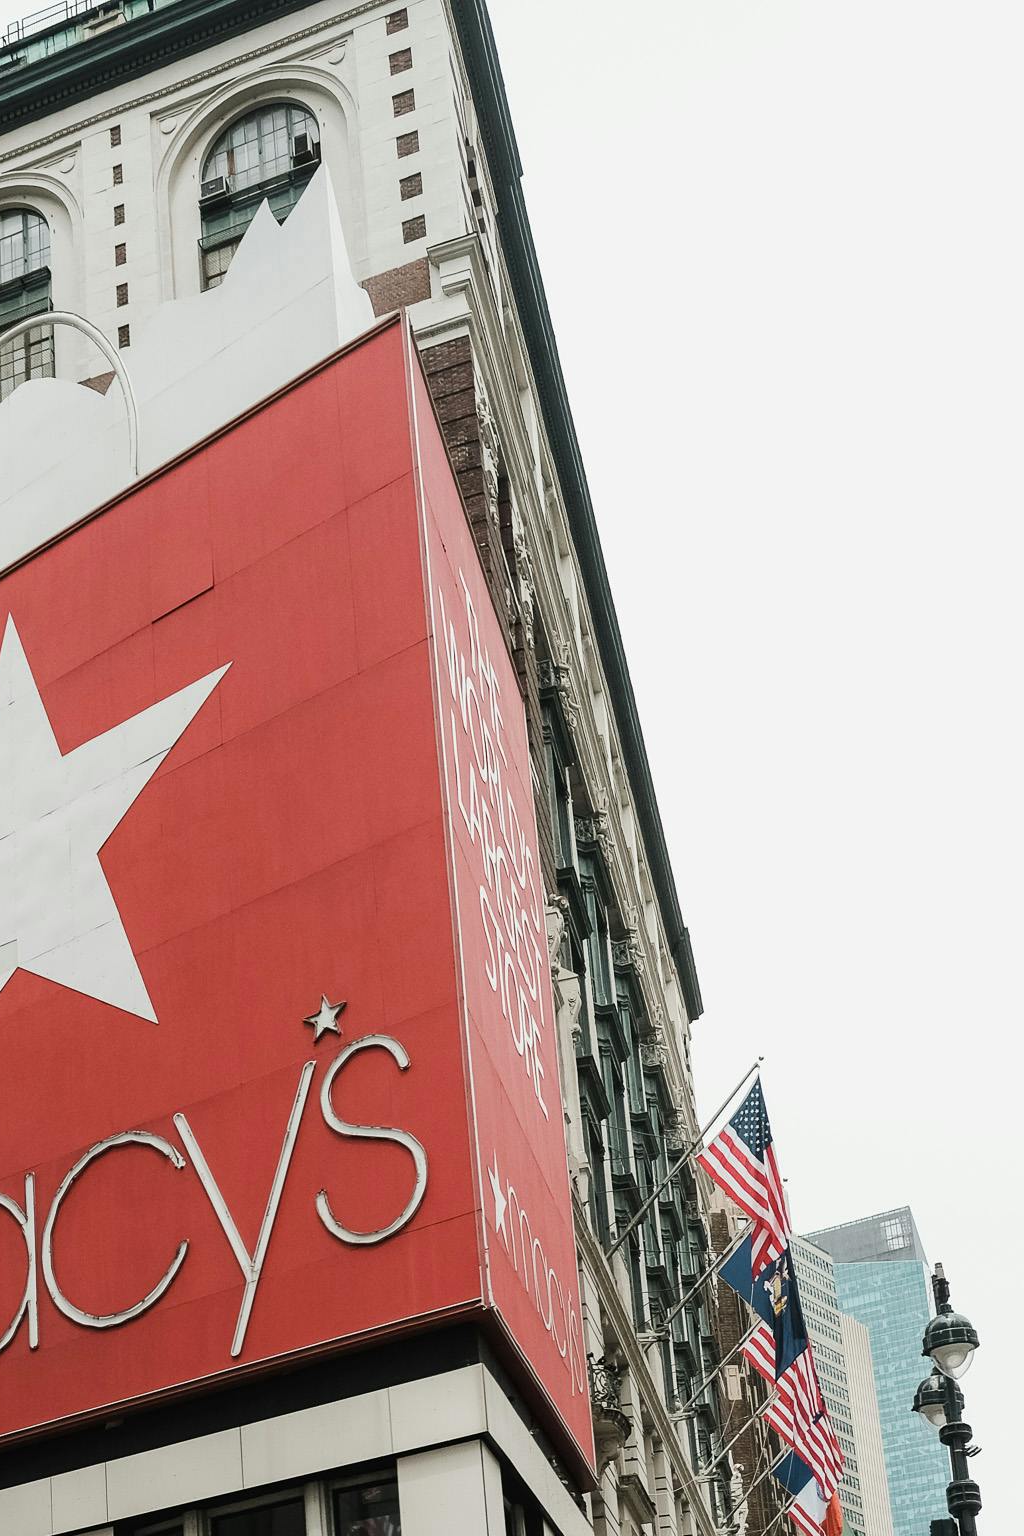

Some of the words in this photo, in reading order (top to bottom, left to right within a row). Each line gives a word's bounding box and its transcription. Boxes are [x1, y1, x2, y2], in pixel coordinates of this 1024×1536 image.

[458, 567, 508, 773] THE
[449, 706, 545, 1030] LARGEST
[479, 882, 549, 1124] STORE
